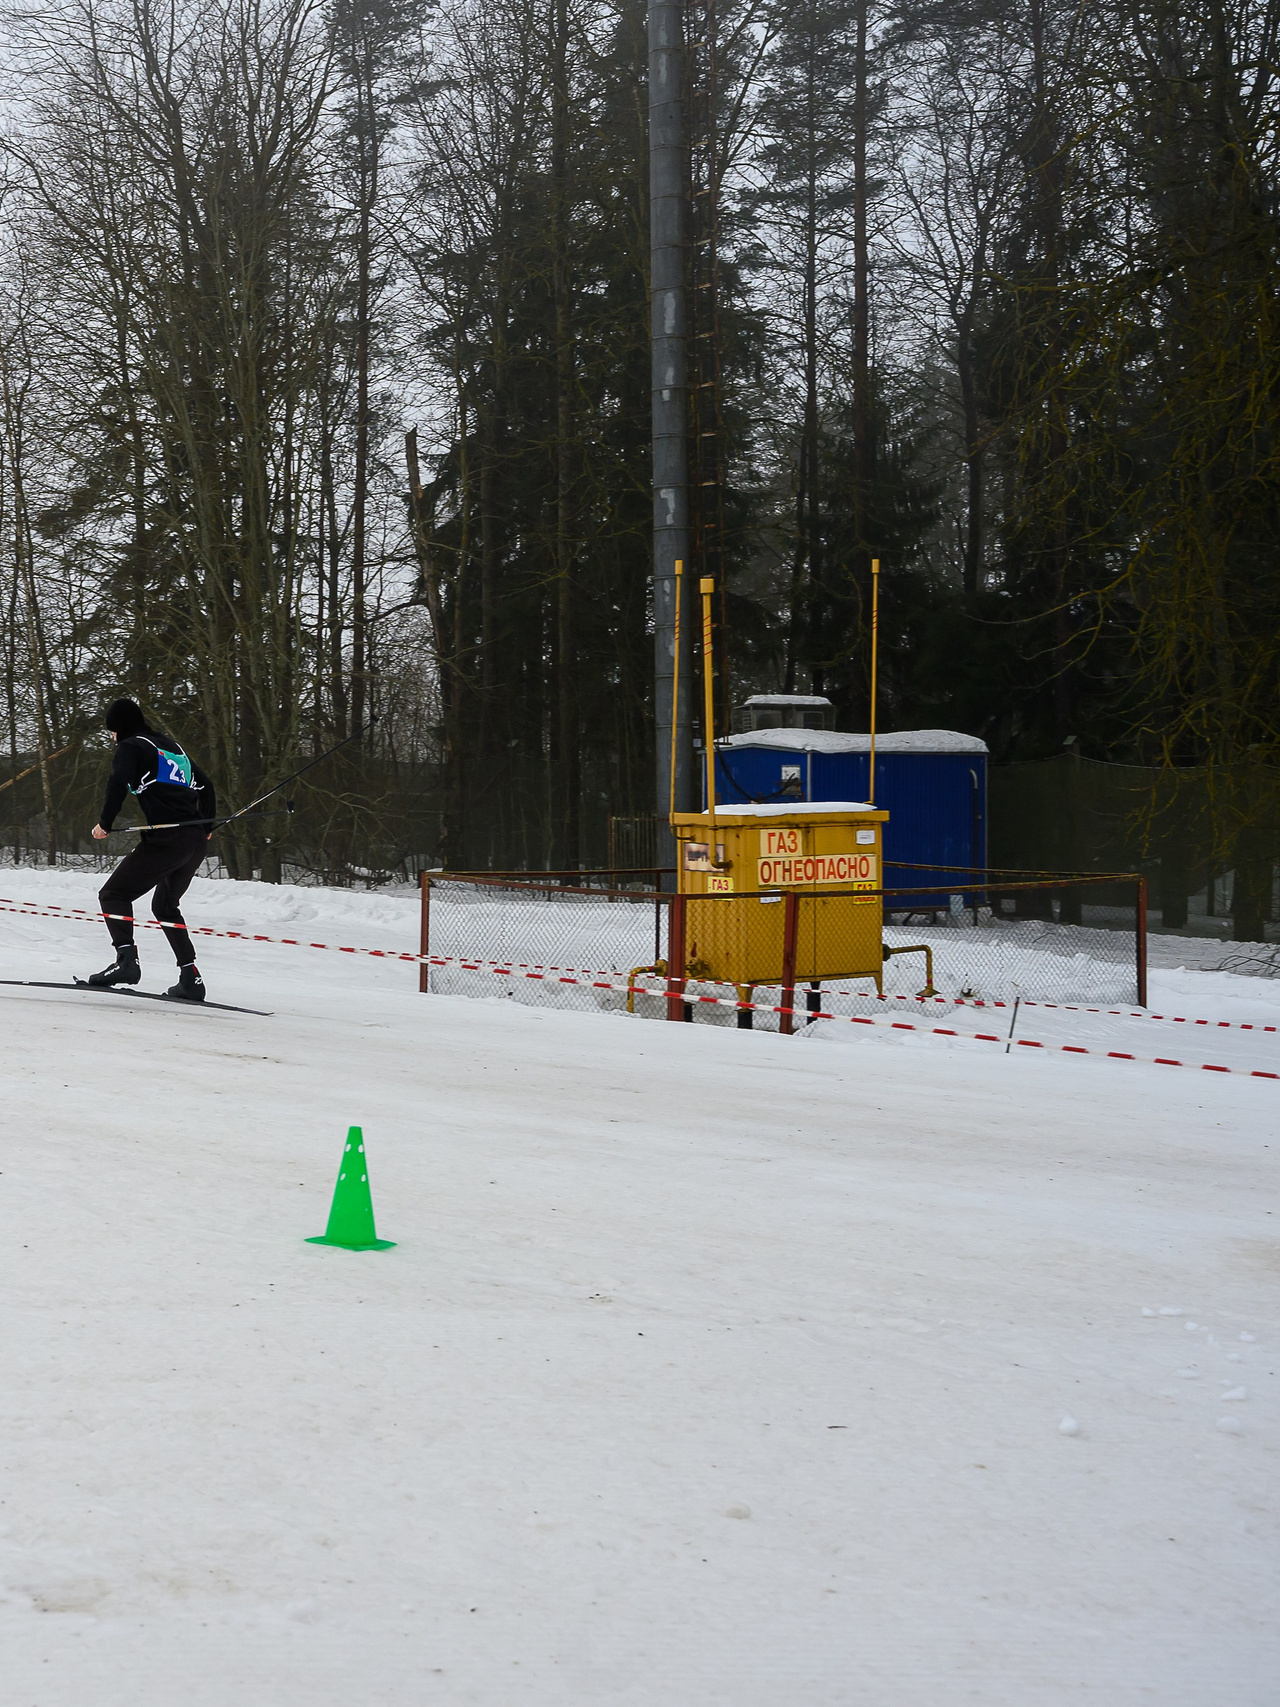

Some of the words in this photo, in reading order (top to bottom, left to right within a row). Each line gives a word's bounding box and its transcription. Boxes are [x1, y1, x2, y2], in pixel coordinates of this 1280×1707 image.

[768, 831, 798, 854] ГАЗ
[760, 856, 870, 883] ОГНЕОПАСНО
[712, 879, 729, 891] ГАЗ
